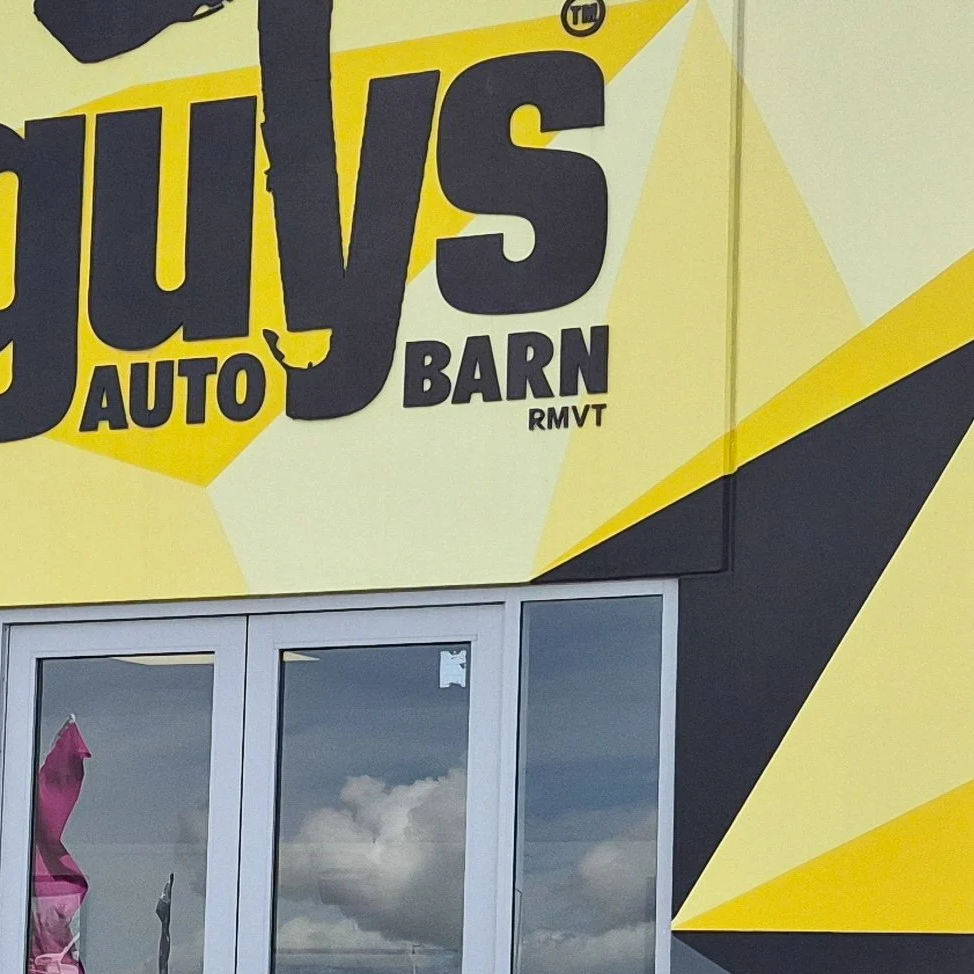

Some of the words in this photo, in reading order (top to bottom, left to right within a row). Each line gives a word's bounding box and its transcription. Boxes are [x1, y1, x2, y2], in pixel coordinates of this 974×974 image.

[570, 2, 598, 25] TM
[78, 352, 266, 432] AUTO
[403, 325, 609, 408] BARN
[528, 403, 607, 431] RMVT
